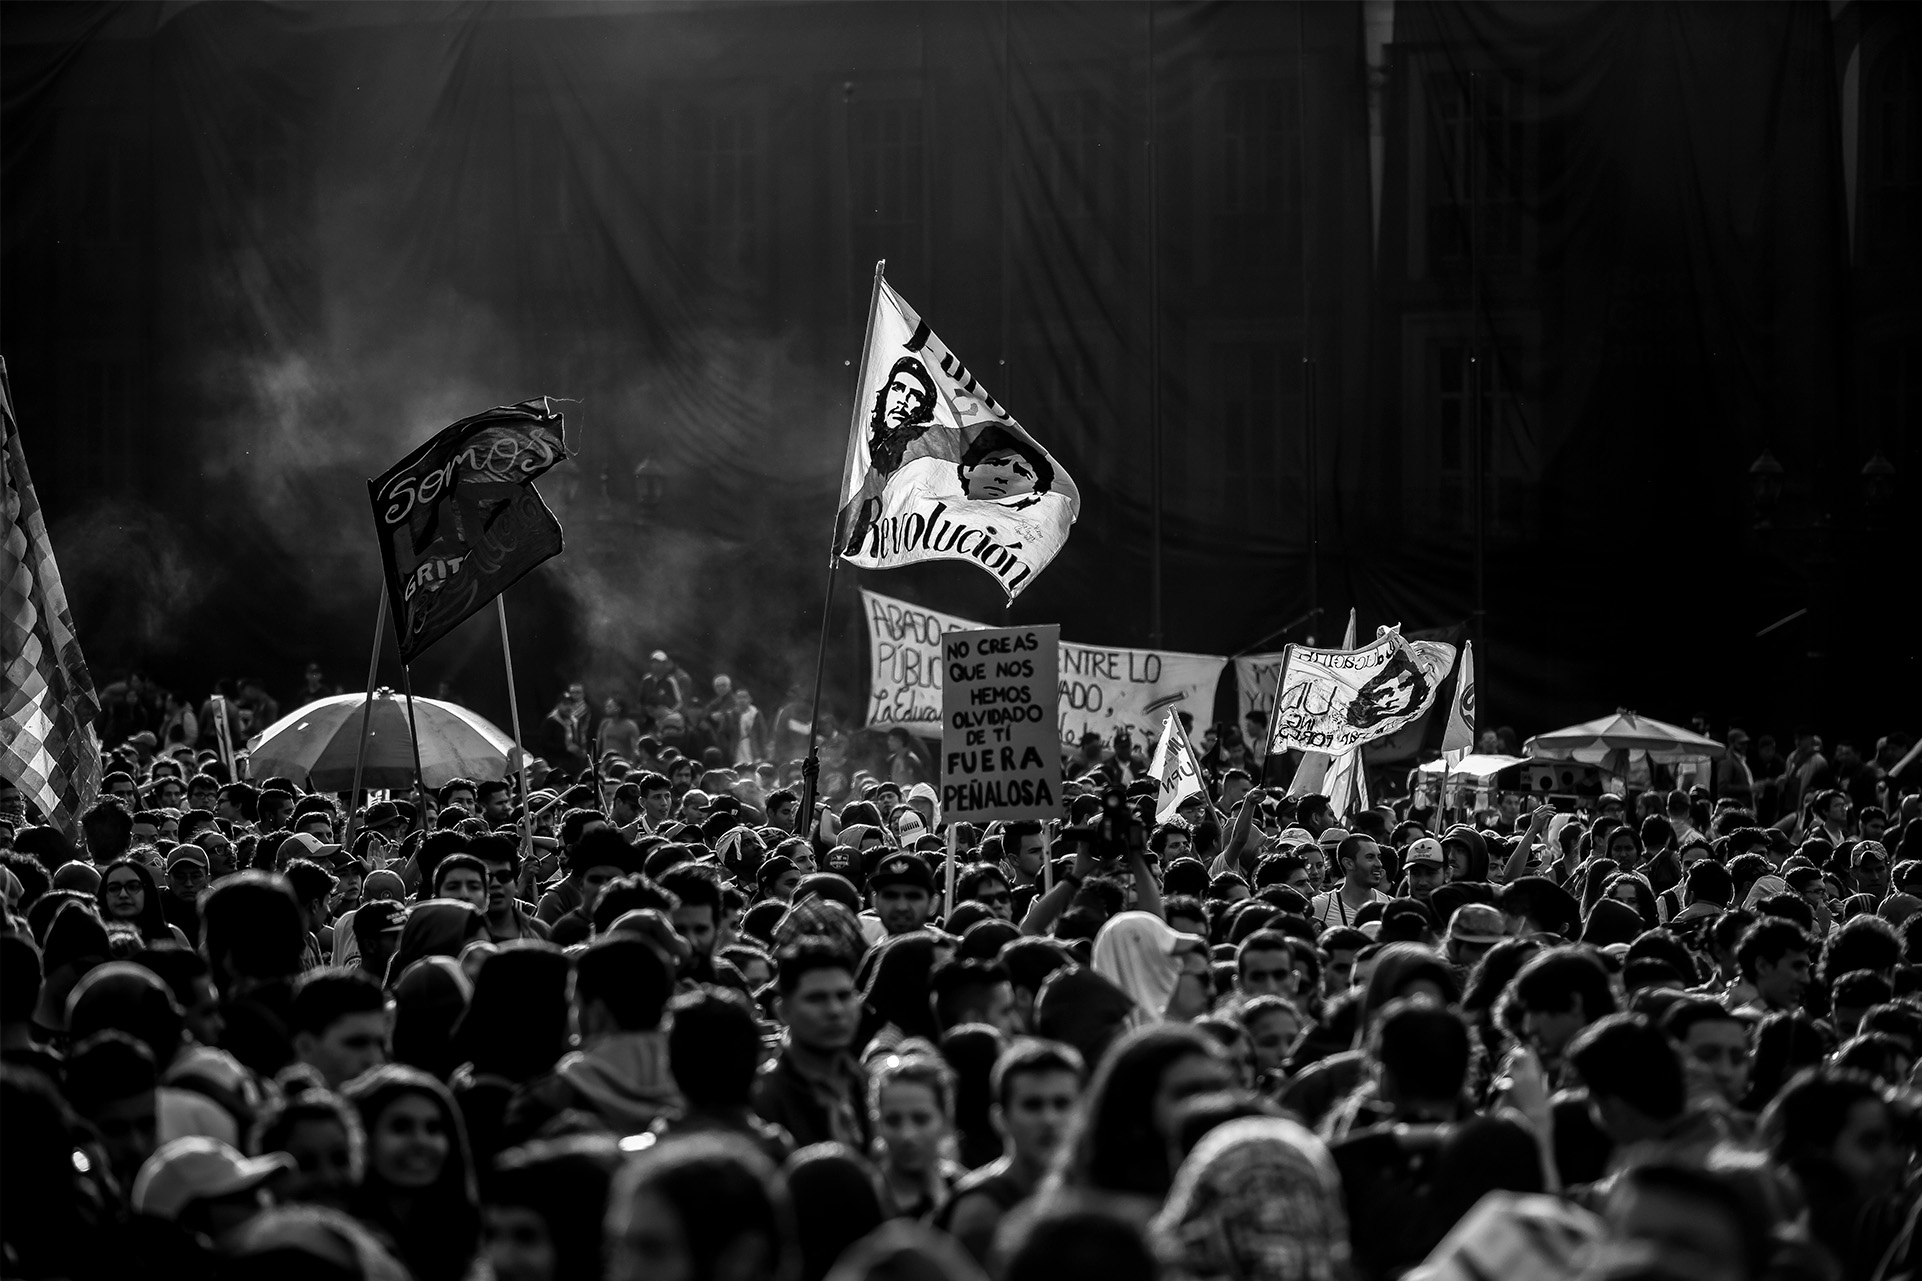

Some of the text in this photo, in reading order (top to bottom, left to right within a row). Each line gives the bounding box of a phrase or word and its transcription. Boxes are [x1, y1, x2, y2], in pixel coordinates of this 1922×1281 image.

[842, 495, 1031, 591] Revolución
[404, 549, 473, 602] GRIT
[872, 599, 942, 647] ABAJO
[947, 632, 1039, 662] NO CREAS
[879, 643, 942, 690] PÚBLIC
[949, 659, 1034, 683] QUE NOS
[1059, 649, 1162, 684] NTRE LO
[894, 685, 942, 722] Educa
[970, 685, 1032, 706] HEMOS
[952, 704, 1044, 730] OLVIDADO
[966, 725, 1011, 746] DE TÍ
[947, 746, 1044, 775] FUERA
[943, 778, 1054, 812] PEÑALOSA
